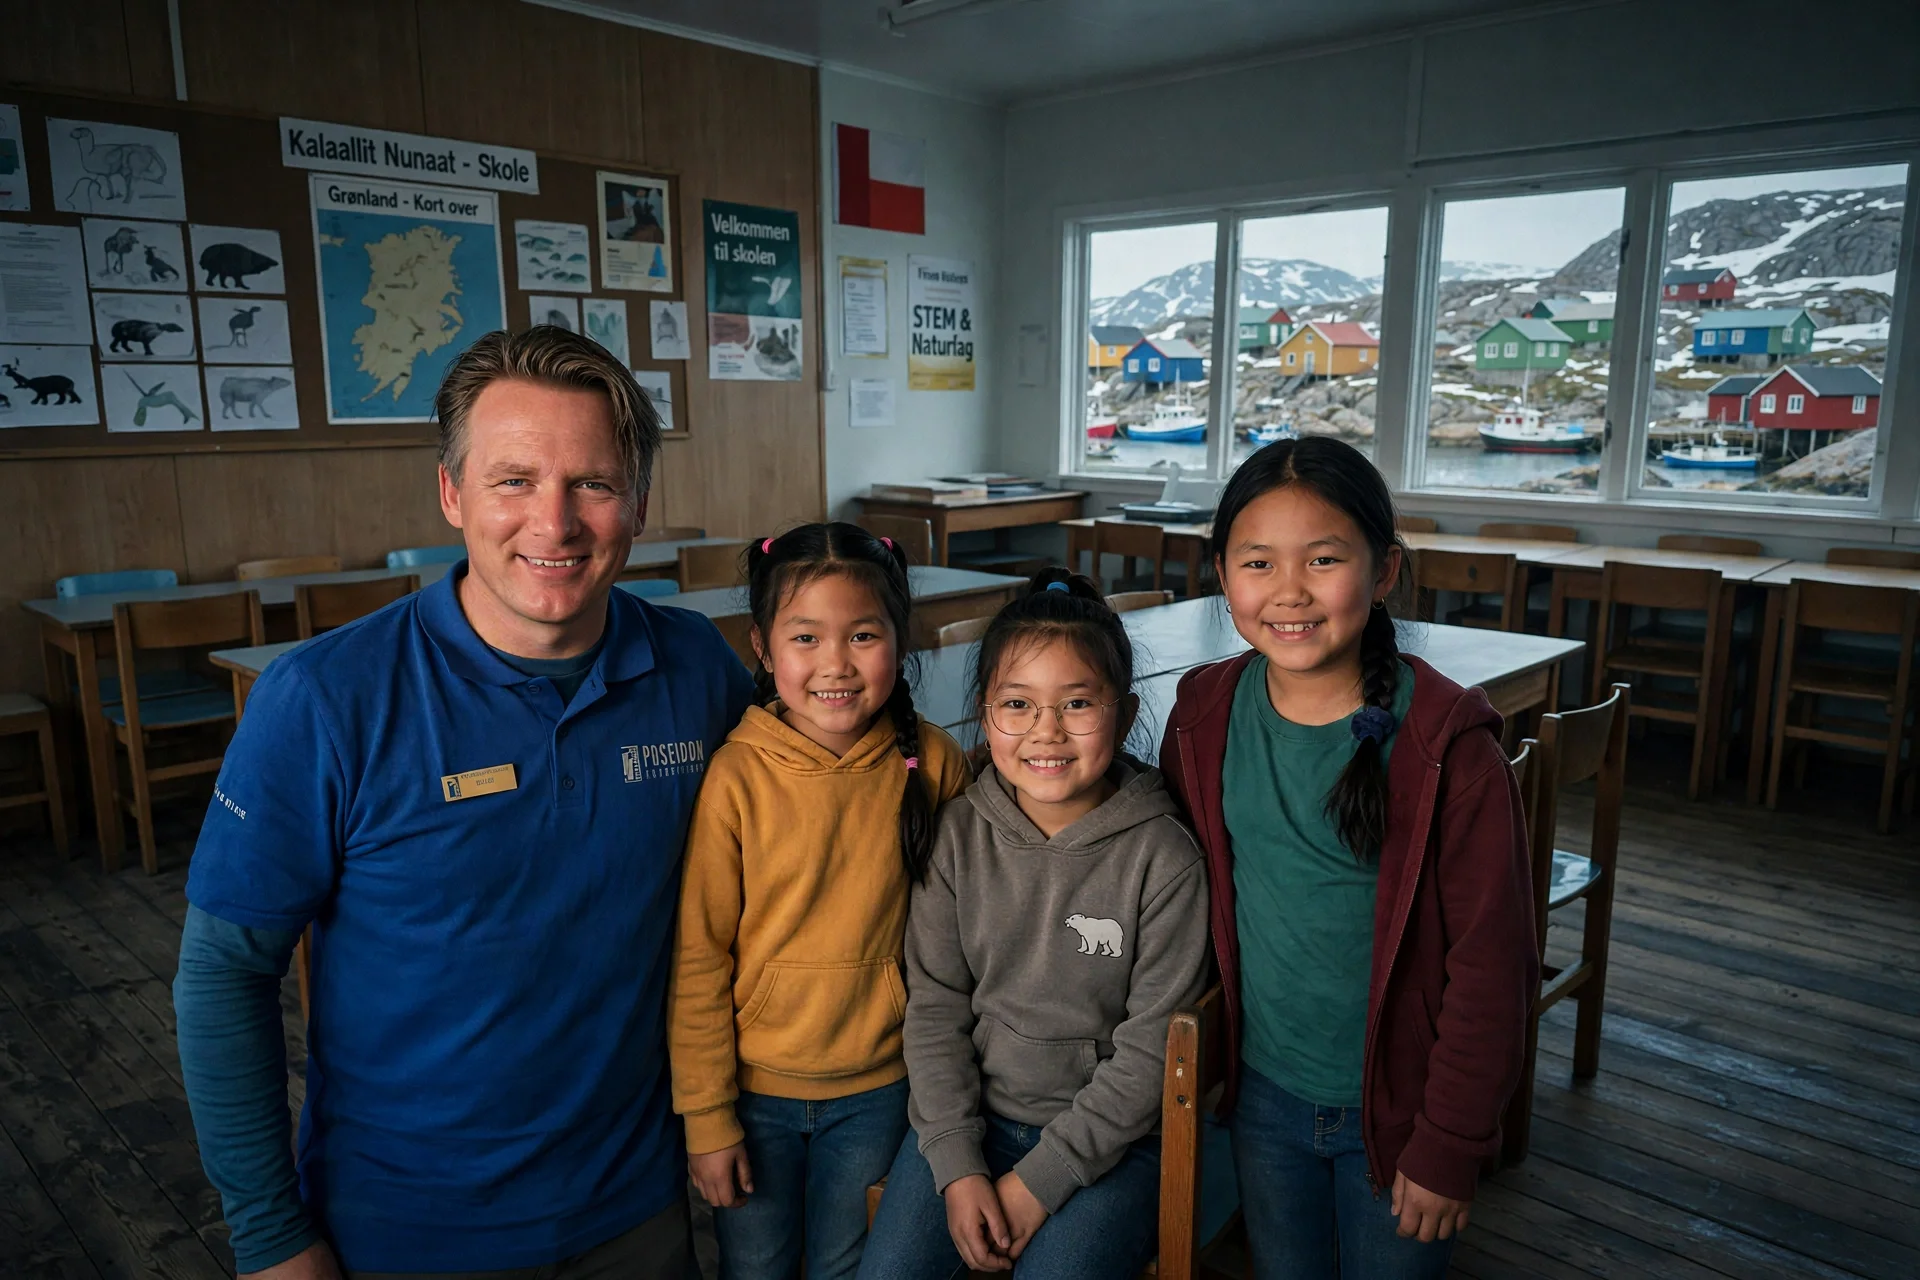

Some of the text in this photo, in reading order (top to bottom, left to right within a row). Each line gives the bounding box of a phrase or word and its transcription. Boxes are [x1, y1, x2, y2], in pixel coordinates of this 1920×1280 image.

[288, 129, 377, 165] Kalaallit
[385, 141, 456, 174] Nunaat
[478, 153, 529, 183] Skole
[328, 185, 398, 208] Grønland
[414, 194, 445, 213] Kort
[448, 202, 478, 216] over
[711, 213, 790, 241] Velkommen
[714, 242, 776, 266] til skolen
[913, 304, 971, 331] STEM &
[642, 740, 704, 768] POSEIDON
